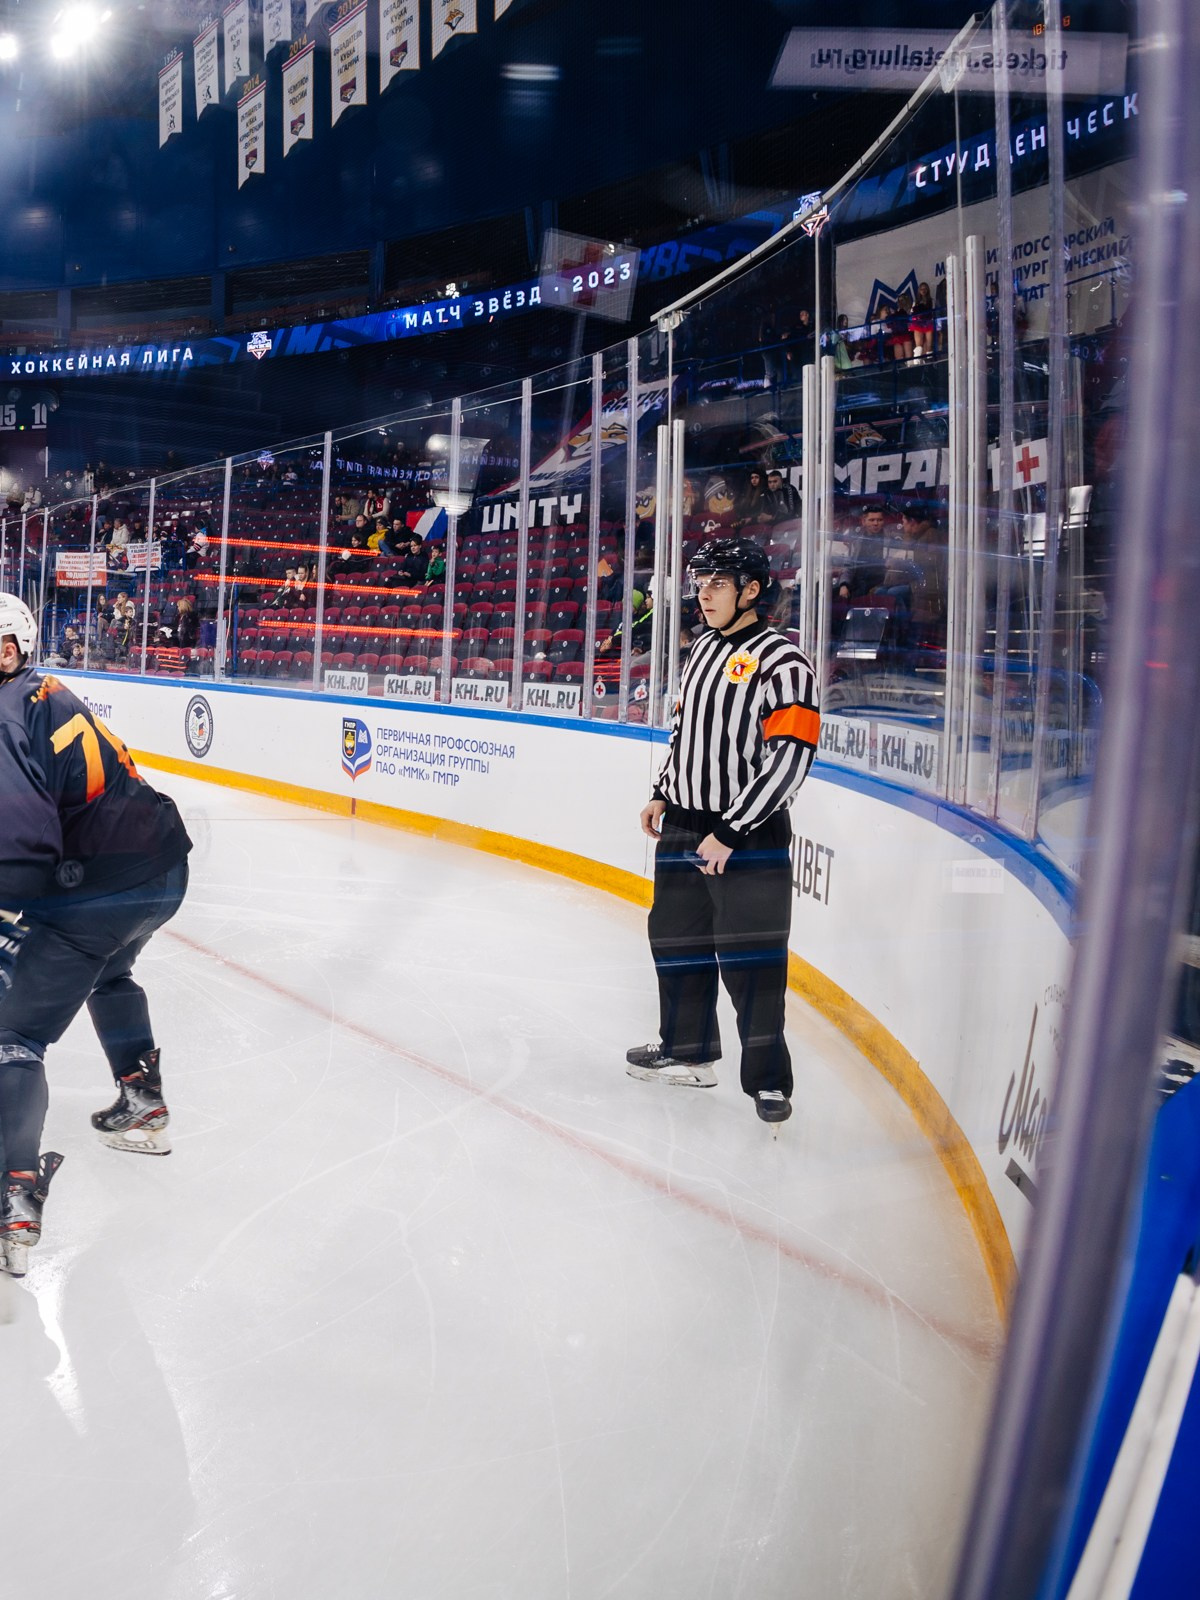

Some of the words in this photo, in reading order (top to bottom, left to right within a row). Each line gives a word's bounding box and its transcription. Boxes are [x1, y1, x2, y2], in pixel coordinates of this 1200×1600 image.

[289, 33, 308, 58] 2014
[914, 91, 1140, 189] СТУДЕНЧЕСК
[405, 305, 461, 329] МАТЧ
[473, 285, 542, 317] ЗВЁЗД
[572, 263, 631, 293] 2023
[11, 352, 130, 375] ХОККЕЙНАЯ
[142, 347, 194, 366] ЛИГА
[481, 493, 582, 532] UNITY
[327, 673, 366, 692] KHL.RU
[386, 678, 432, 698] KHL.RU
[454, 682, 506, 704] KHL.RU
[526, 687, 577, 710] KHL.RU
[818, 721, 869, 759] KHL.RU
[880, 733, 936, 780] KHL.RU
[376, 727, 431, 746] ПЕРВИЧНАЯ
[433, 735, 516, 759] ПРОФСОЮЗНАЯ
[375, 744, 446, 767] ОРГАНИЗАЦИЯ
[448, 755, 490, 775] ГРУППЫ
[375, 763, 396, 776] ПАО
[398, 766, 431, 782] «ММК»
[432, 771, 460, 788] ГМПР
